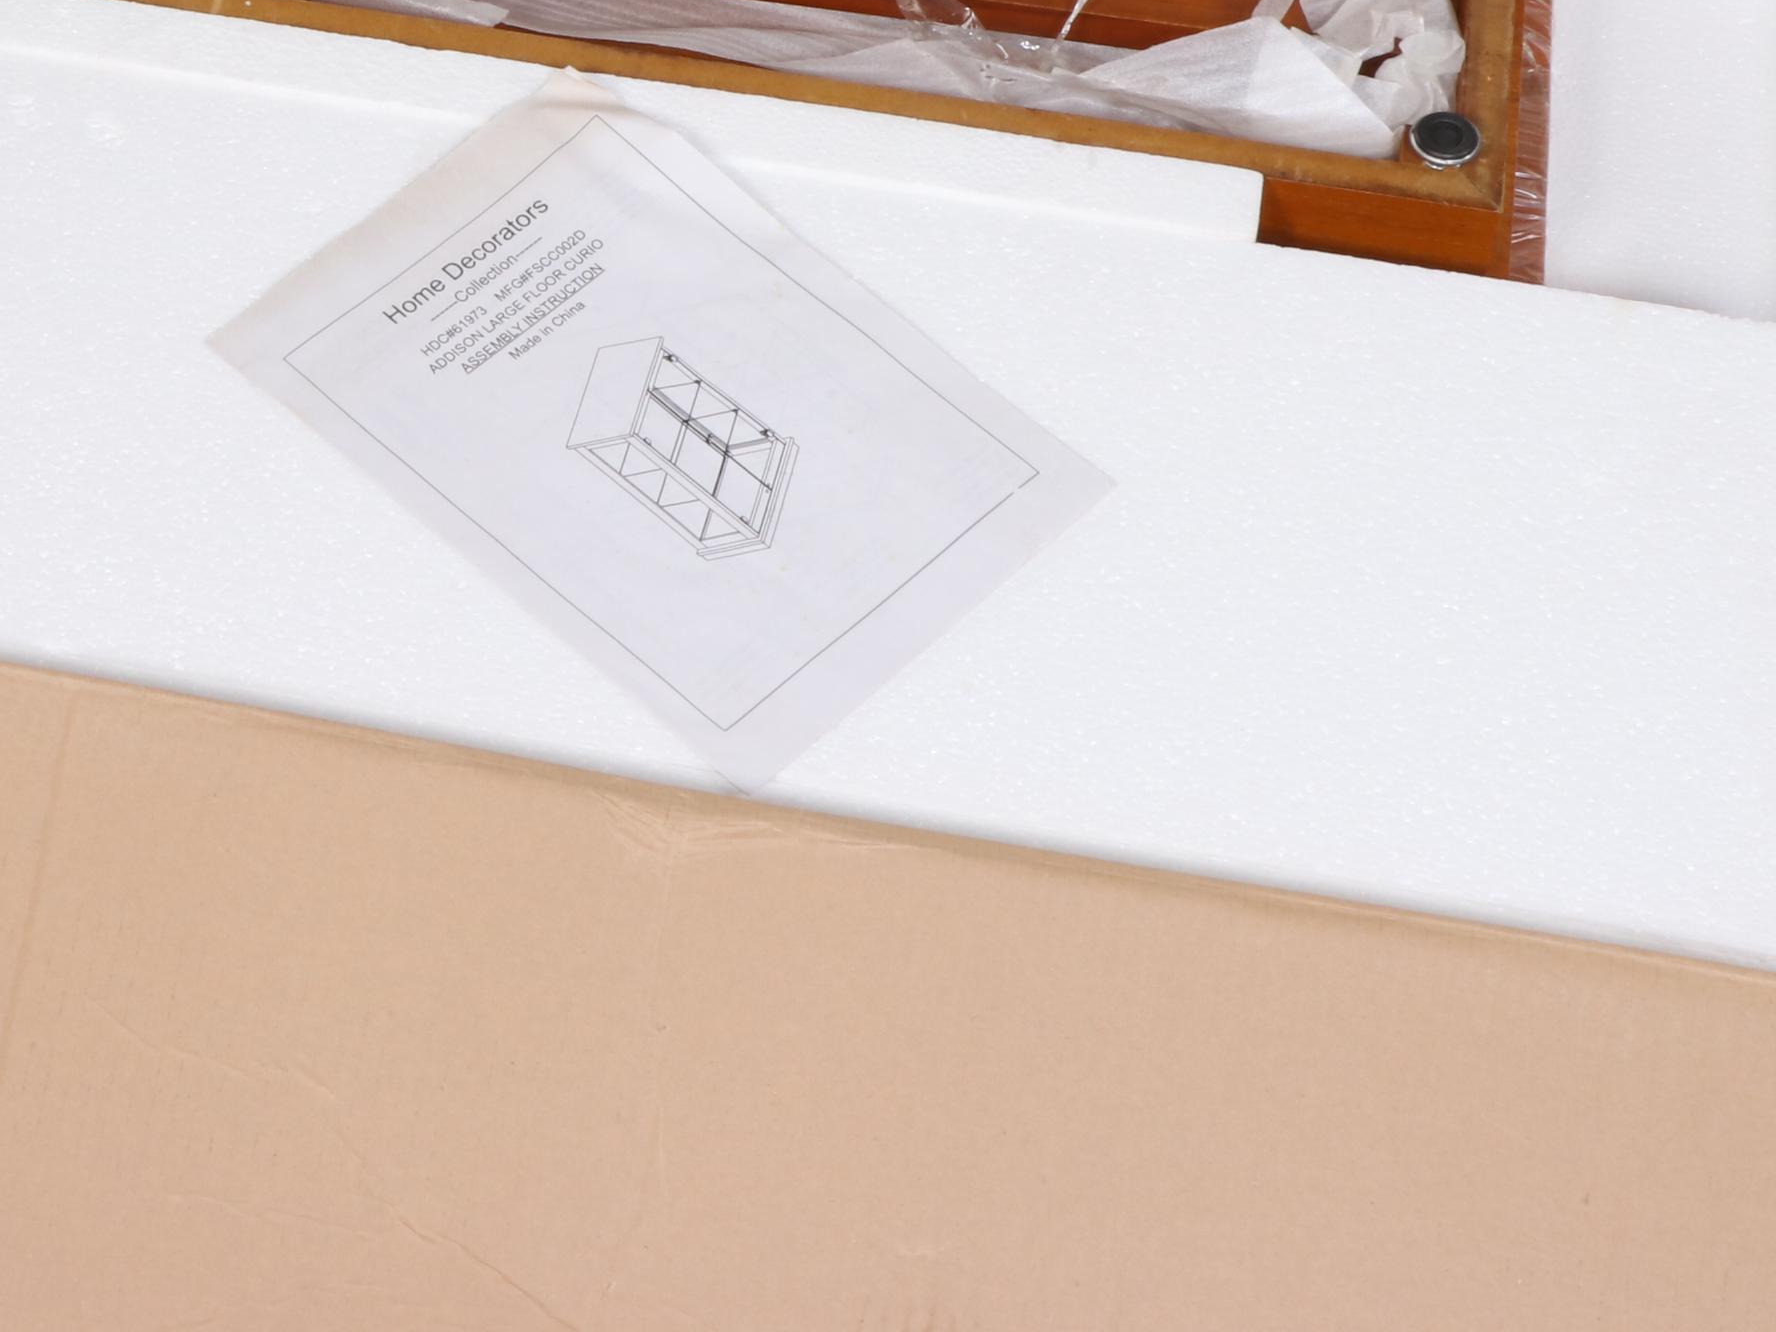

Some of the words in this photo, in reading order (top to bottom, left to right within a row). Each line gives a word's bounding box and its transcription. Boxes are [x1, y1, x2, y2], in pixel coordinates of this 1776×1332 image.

[382, 278, 446, 324] Home
[441, 199, 549, 281] Decorators
[419, 304, 488, 357] HDC#61973
[494, 228, 587, 302] MFG#FSCC002D
[428, 329, 484, 375] ADDISON
[481, 299, 526, 334] LARGE
[523, 267, 567, 304] FLOOR
[563, 237, 605, 273] CURIO
[460, 321, 524, 375] ASSEMBLY
[523, 262, 605, 329] INSTRUCTION
[508, 330, 543, 361] Made
[541, 322, 554, 337] in
[551, 300, 586, 328] China
